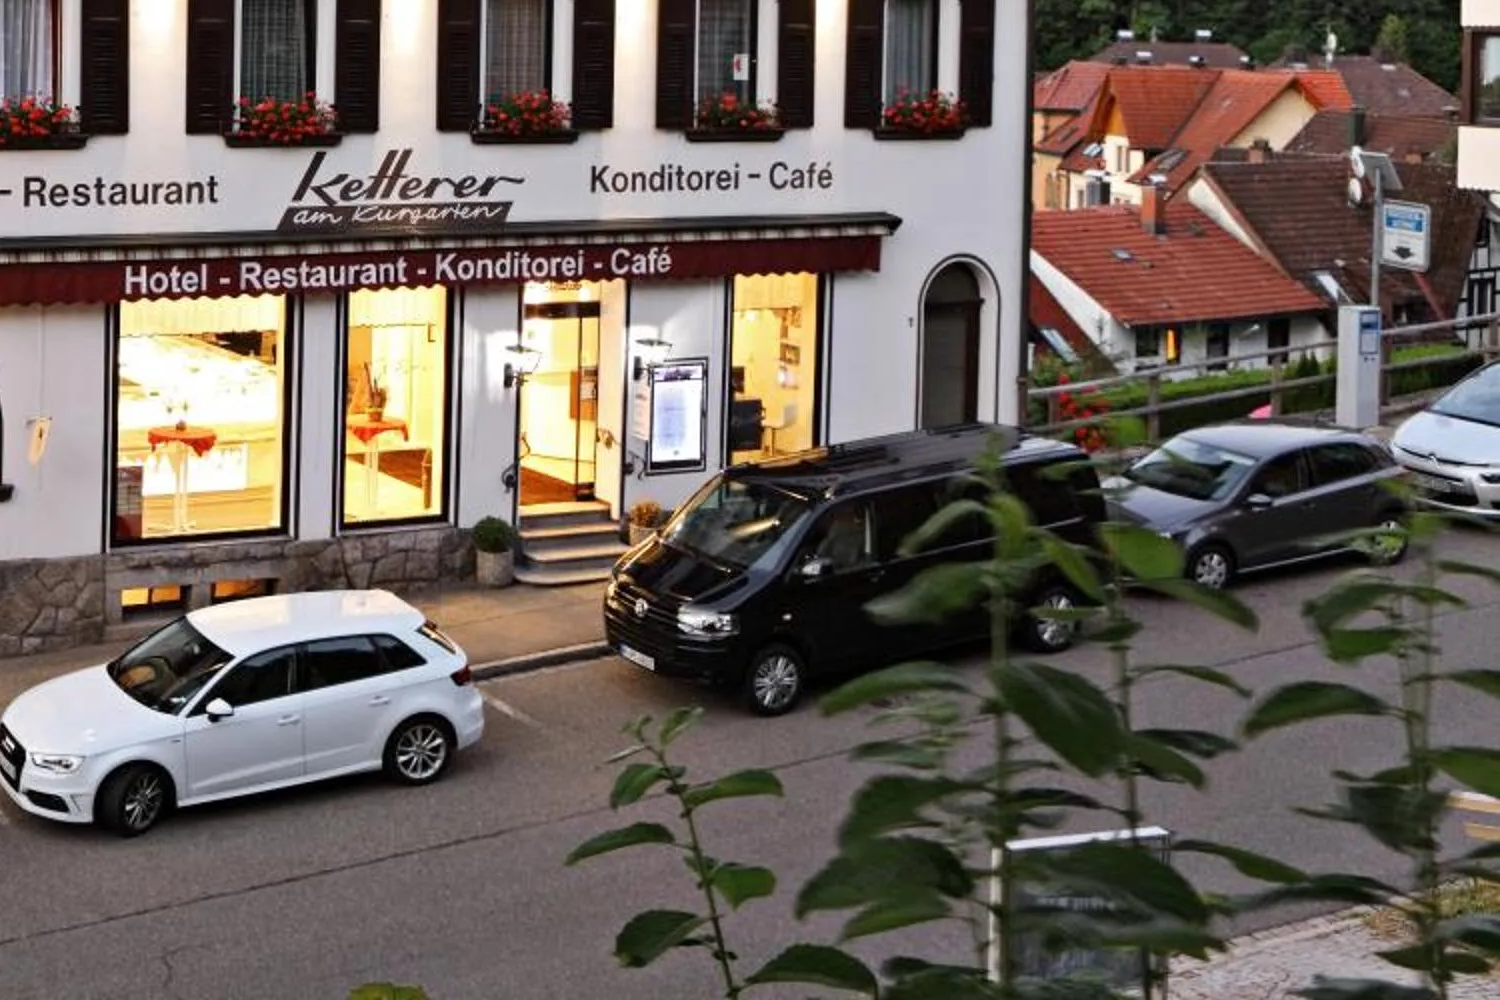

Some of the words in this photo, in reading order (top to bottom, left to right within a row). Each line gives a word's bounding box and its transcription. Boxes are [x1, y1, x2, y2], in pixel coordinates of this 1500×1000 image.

[23, 176, 218, 207] Restaurant
[291, 149, 526, 207] Ketterer
[590, 163, 741, 193] Konditorei
[769, 161, 833, 190] Café
[293, 208, 344, 225] am
[351, 201, 501, 225] Kurgarten
[125, 264, 207, 294] Hotel
[240, 257, 407, 290] Restaurant
[435, 250, 583, 281] Konditorei
[611, 246, 672, 275] Café
